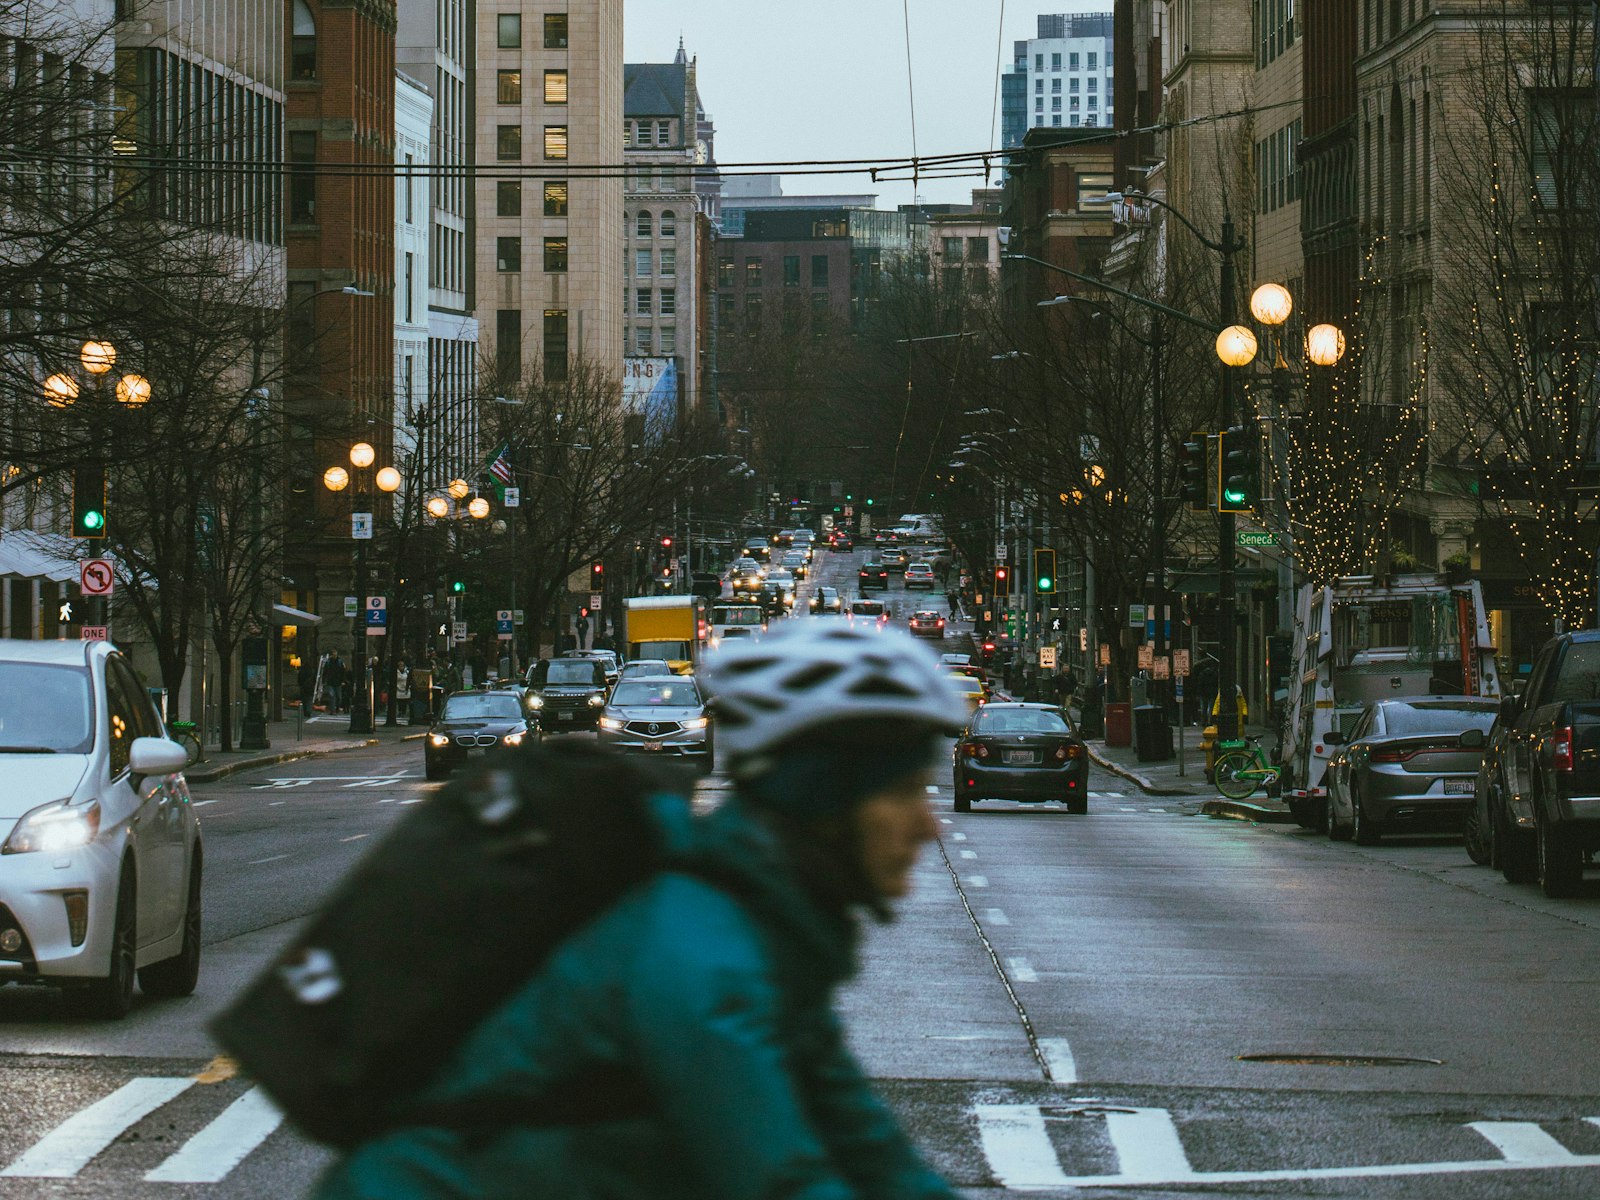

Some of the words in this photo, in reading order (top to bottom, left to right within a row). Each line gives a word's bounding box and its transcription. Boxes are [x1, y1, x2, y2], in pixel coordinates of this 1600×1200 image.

[1240, 533, 1273, 545] Seneca
[372, 610, 380, 620] 2
[502, 621, 508, 629] 2
[84, 629, 104, 638] ONE
